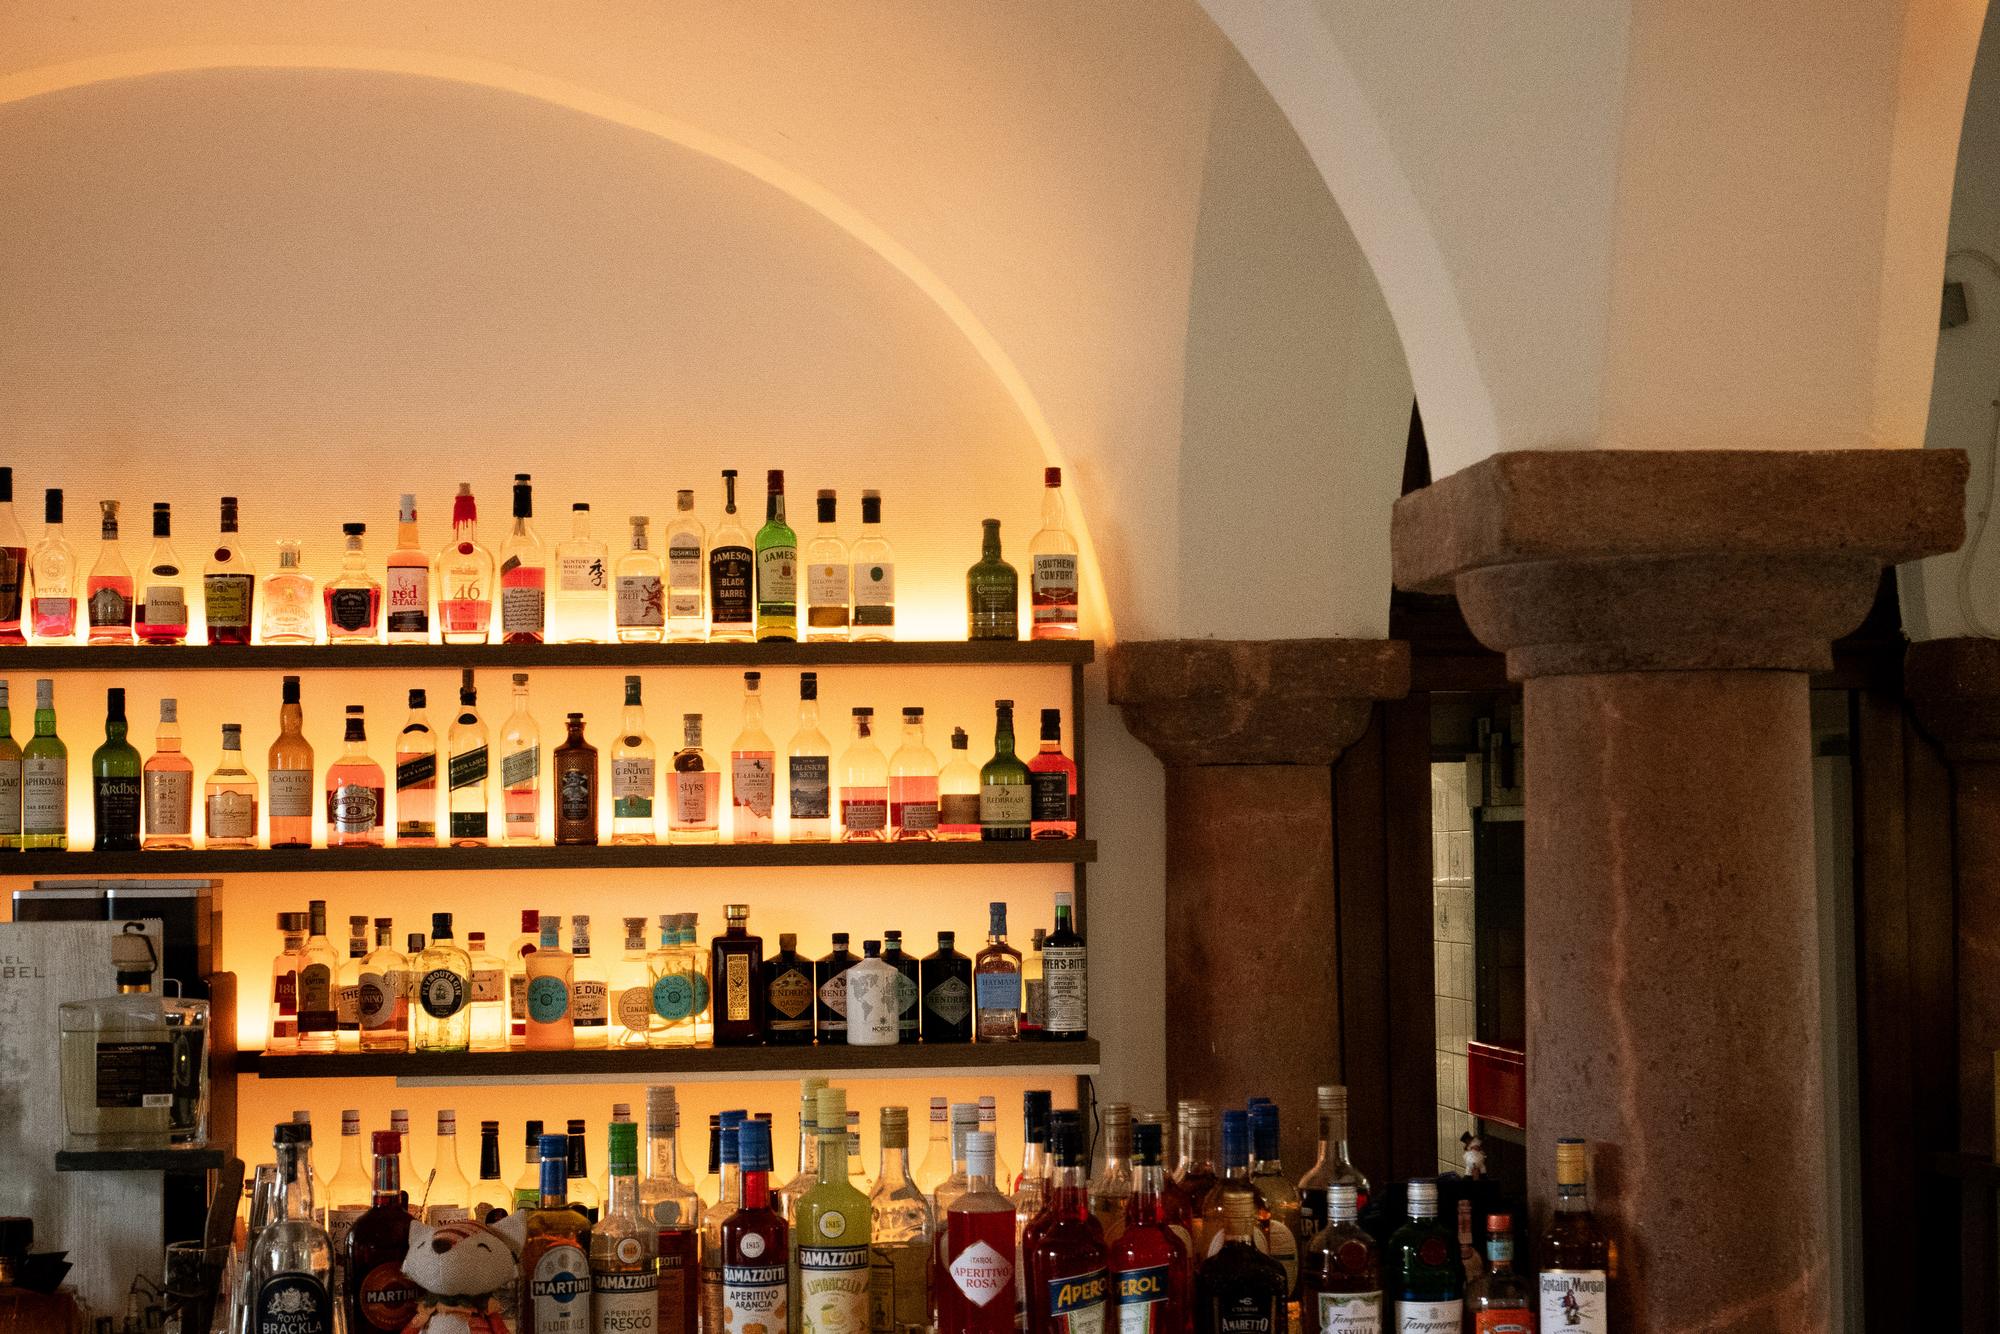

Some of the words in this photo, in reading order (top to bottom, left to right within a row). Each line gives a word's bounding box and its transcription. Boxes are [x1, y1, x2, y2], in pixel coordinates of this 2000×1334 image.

[633, 538, 641, 549] 4
[670, 549, 700, 557] BUSHMILLS
[712, 551, 751, 564] JAMESON
[1038, 558, 1075, 569] SOUTHERN
[1040, 570, 1073, 581] COMFORT
[721, 577, 745, 587] BLACK
[391, 584, 418, 599] red
[453, 577, 481, 601] 46
[719, 589, 747, 598] BARREL
[151, 599, 181, 608] Hennessy
[391, 598, 417, 606] STAG
[615, 767, 651, 776] GENLIVET
[25, 776, 65, 787] APHROAIG
[627, 775, 639, 784] 12
[986, 796, 1024, 804] REDBREAST
[1000, 810, 1011, 818] 15
[422, 970, 456, 996] PLYMOUTH
[341, 990, 360, 1000] THE
[585, 984, 607, 996] DUKE
[799, 1250, 869, 1267] RAMAZZOTTI
[724, 1266, 785, 1283] RAMAZZOTTI
[954, 1267, 1009, 1278] APERITIVO
[535, 1279, 589, 1294] MARTINI
[966, 1279, 998, 1289] ROSA
[1119, 1275, 1160, 1297] EROL
[730, 1290, 779, 1301] APERITIVO
[735, 1301, 773, 1311] ARANCIA
[277, 1313, 309, 1323] ROYAL
[603, 1308, 652, 1317] APERITIVO
[262, 1321, 322, 1334] BRACKLA
[603, 1316, 651, 1331] FRESCO
[1222, 1317, 1269, 1332] AMARETTO
